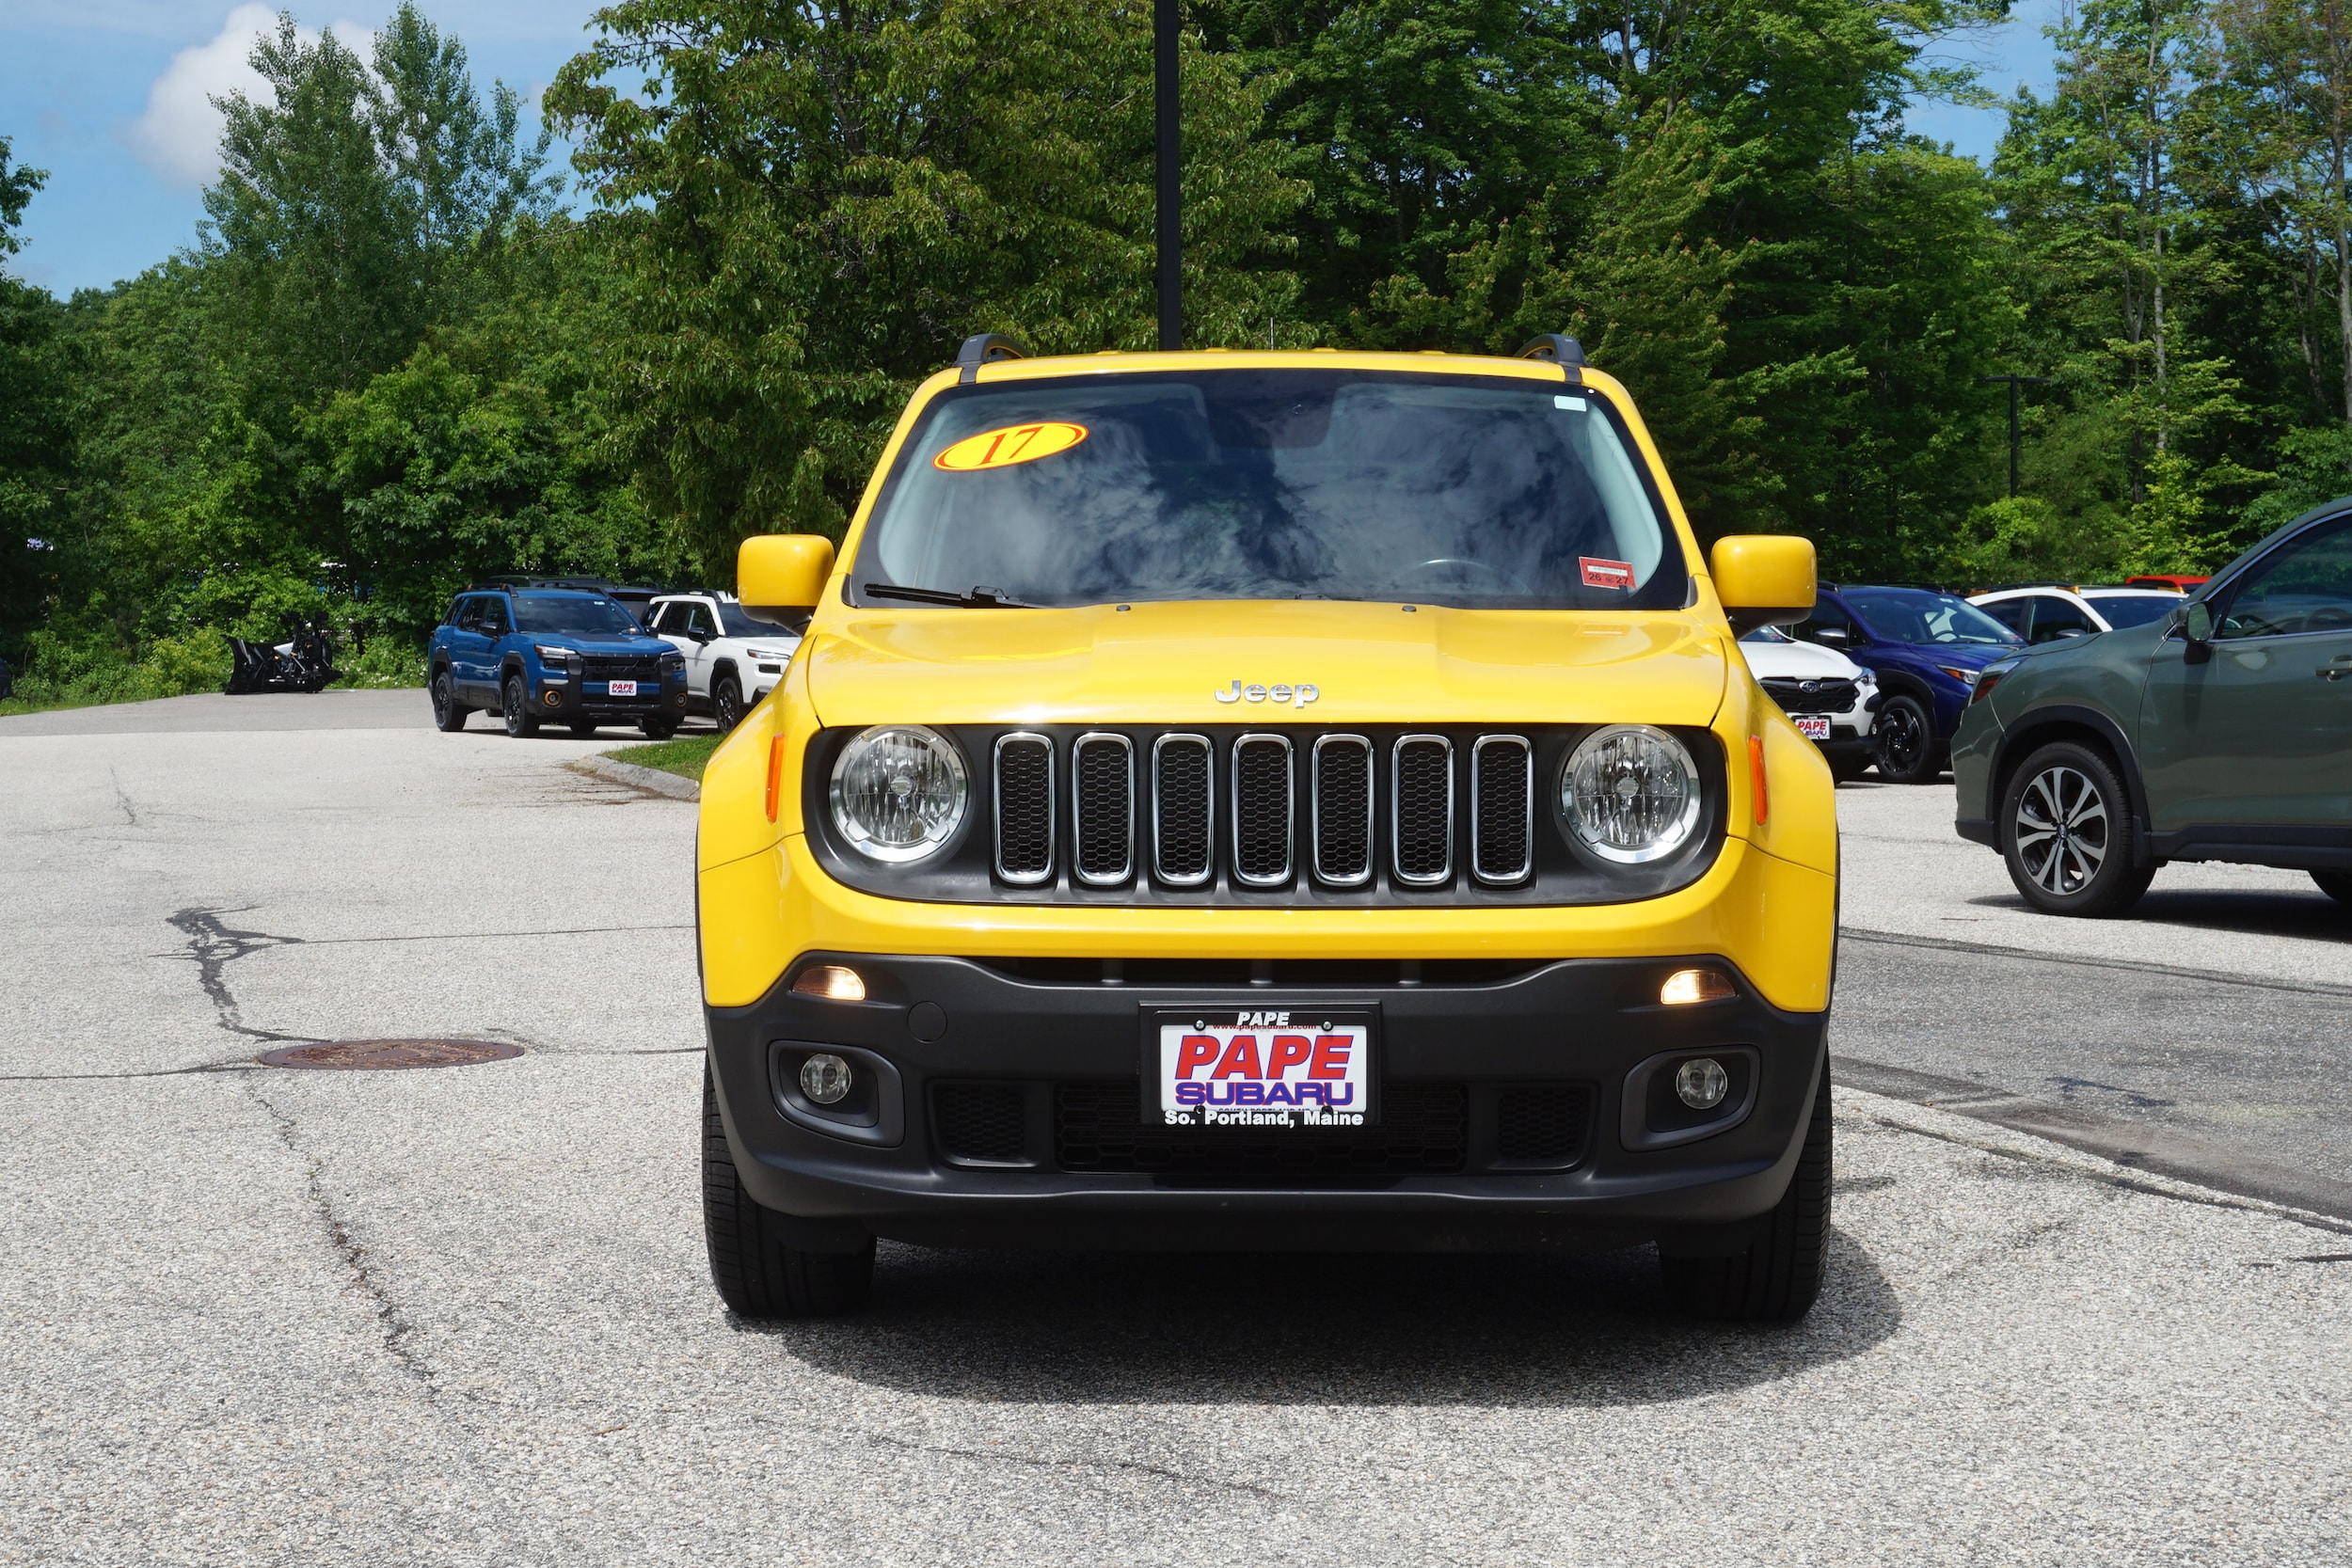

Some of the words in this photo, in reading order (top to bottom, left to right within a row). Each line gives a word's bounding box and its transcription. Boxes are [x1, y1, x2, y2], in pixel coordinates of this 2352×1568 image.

[974, 425, 1044, 467] 17
[1615, 576, 1629, 584] 27
[1215, 680, 1319, 708] Jeep
[1798, 721, 1827, 731] PAPE
[1236, 1012, 1290, 1025] PAPE
[1175, 1035, 1354, 1080] PAPE
[1175, 1083, 1353, 1105] SUBARU
[1165, 1110, 1196, 1125] So.
[1204, 1109, 1295, 1129] Portland,
[1303, 1109, 1364, 1126] Maine
